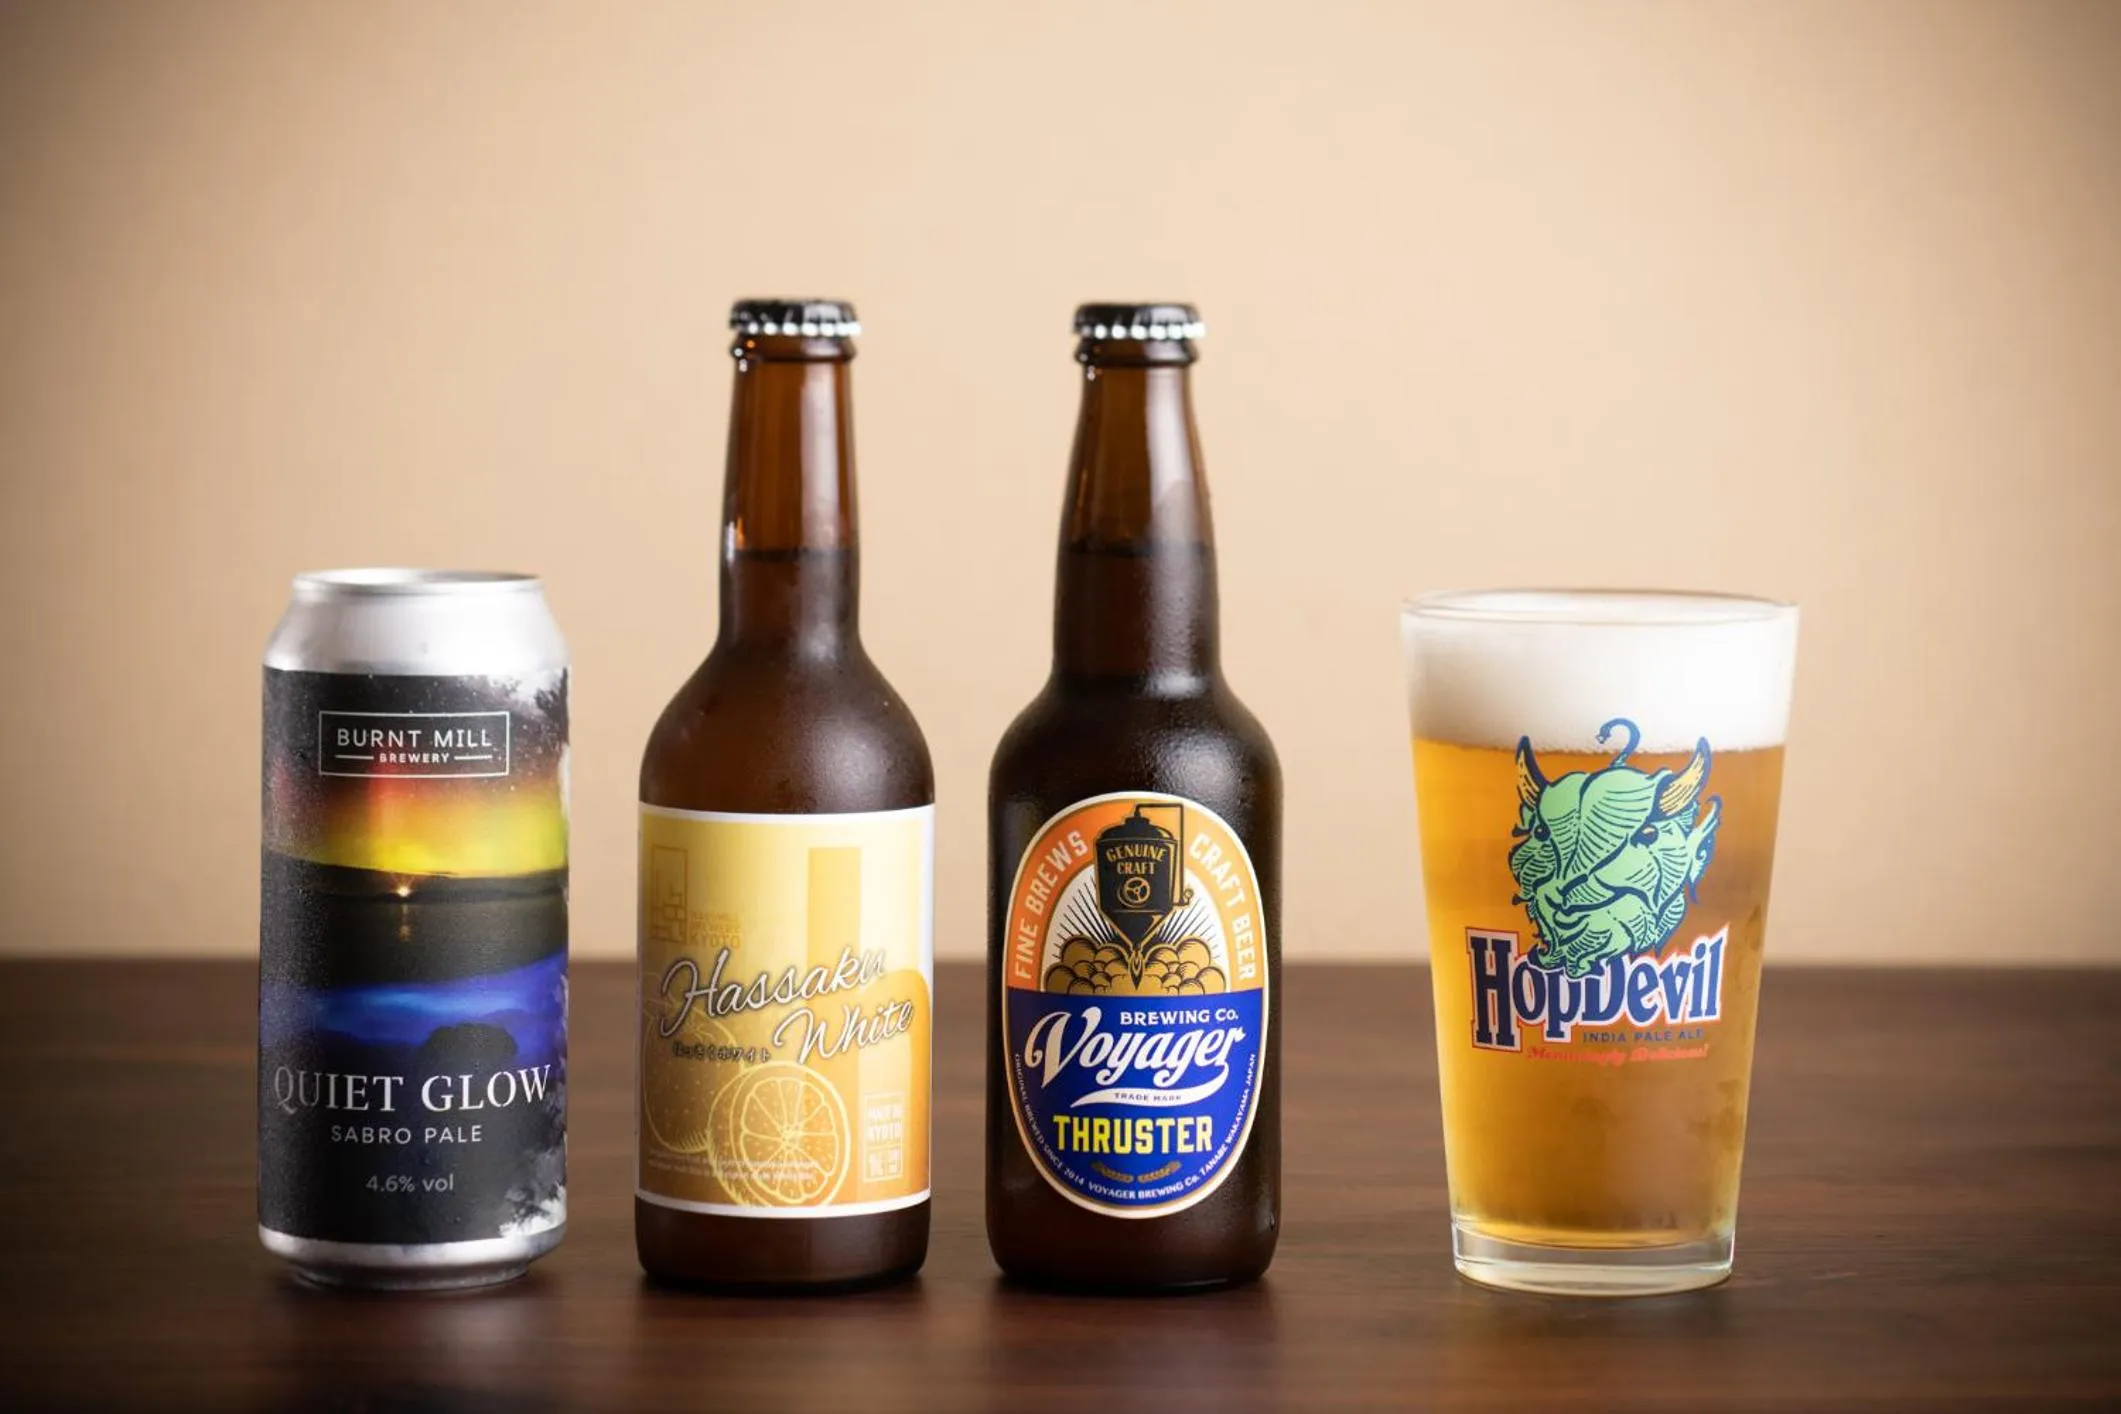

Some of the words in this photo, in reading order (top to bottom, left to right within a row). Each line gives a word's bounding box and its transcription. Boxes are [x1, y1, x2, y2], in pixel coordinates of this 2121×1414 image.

[336, 728, 422, 748] BURNT
[433, 728, 492, 748] MILL
[379, 753, 450, 764] BREWERY
[1105, 843, 1168, 863] GENUINE
[1116, 861, 1155, 875] CRAFT
[1024, 830, 1088, 916] BREWS
[1189, 832, 1246, 909] CRAFT
[1231, 912, 1256, 981] BEER
[1015, 917, 1038, 980] FINE
[660, 946, 885, 1036] Hassaku
[1467, 926, 1727, 1051] HopDevil
[774, 1000, 914, 1065] White
[1119, 1008, 1210, 1026] BREWING
[1214, 1007, 1239, 1022] Co.
[1582, 1032, 1627, 1043] INDIA
[1633, 1030, 1673, 1042] PALE
[1677, 1029, 1705, 1040] ALE
[1024, 1006, 1247, 1089] Voyager
[274, 1065, 404, 1115] QUIET
[421, 1064, 551, 1112] GLOW
[1113, 1092, 1149, 1101] TRADE
[1153, 1093, 1182, 1102] MARK
[331, 1125, 411, 1145] SABRO
[425, 1125, 483, 1144] PALE
[1024, 1103, 1045, 1144] BREWED
[1044, 1144, 1063, 1170] SINCE
[1064, 1166, 1085, 1186] 2014
[1088, 1181, 1136, 1199] VOYAGER
[1137, 1182, 1184, 1199] BREWING
[1200, 1143, 1229, 1176] TANABE
[1224, 1087, 1250, 1144] WAKAYAMA
[1246, 1053, 1256, 1086] JAPAN
[1053, 1115, 1213, 1154] THRUSTER
[366, 1175, 415, 1192] 4.6%
[422, 1173, 454, 1192] vol
